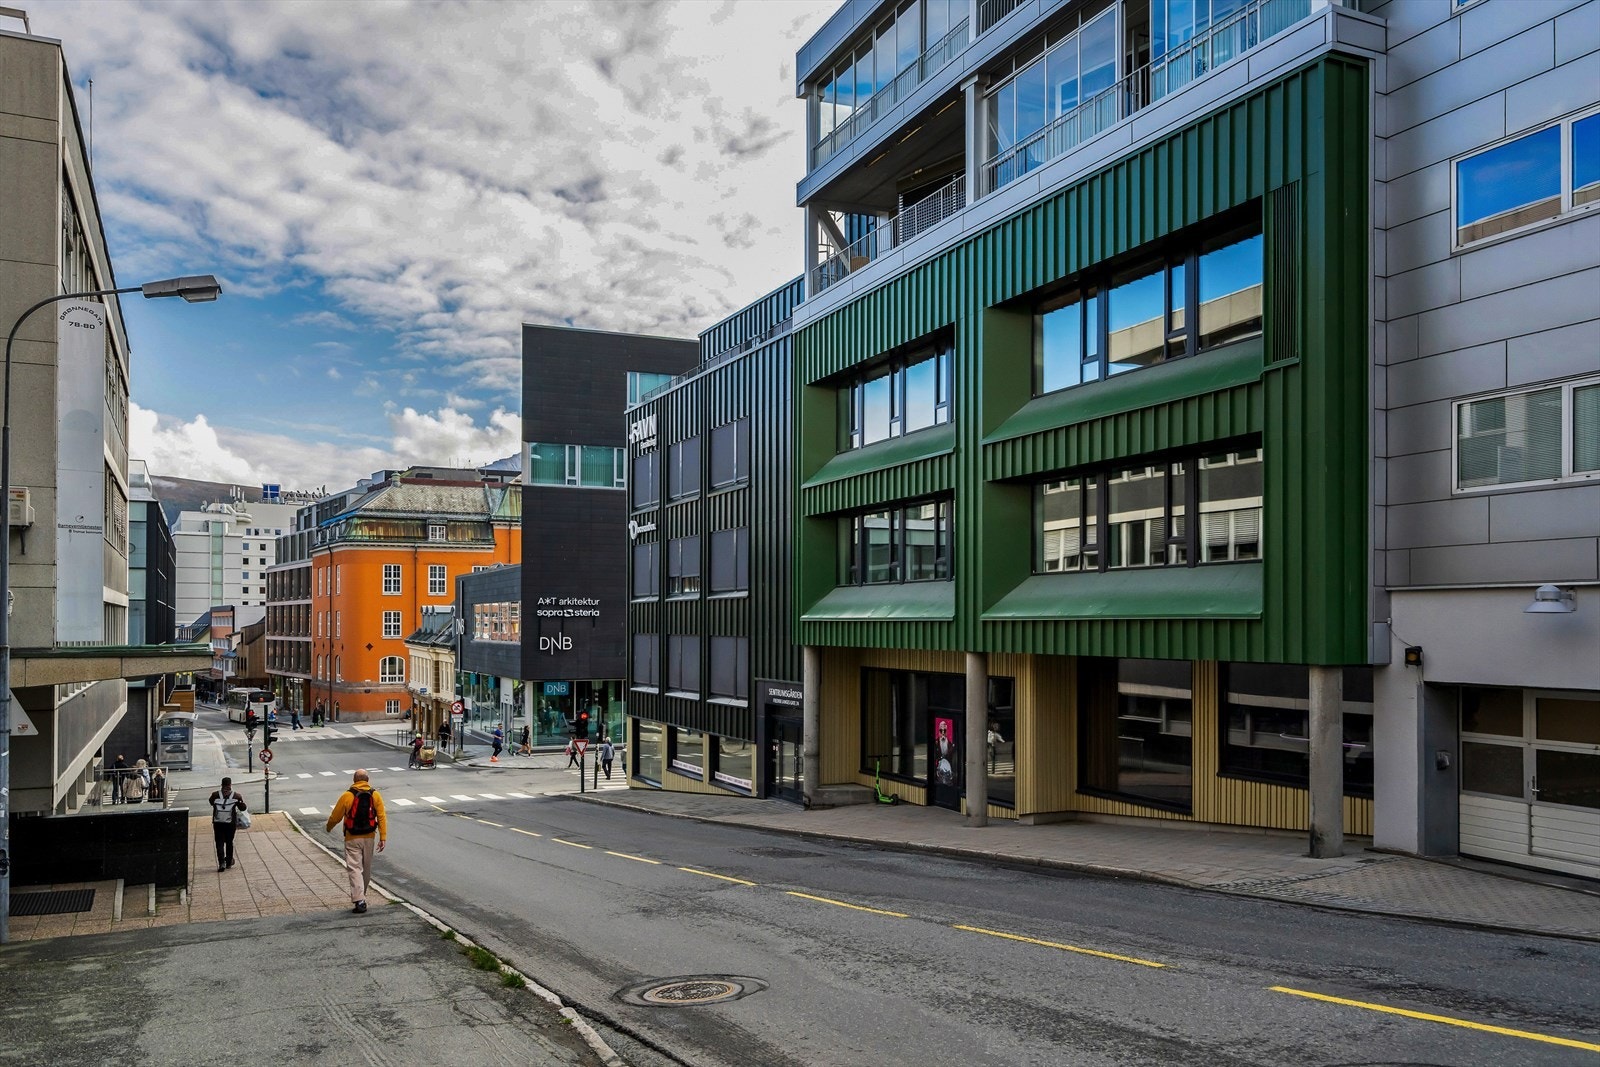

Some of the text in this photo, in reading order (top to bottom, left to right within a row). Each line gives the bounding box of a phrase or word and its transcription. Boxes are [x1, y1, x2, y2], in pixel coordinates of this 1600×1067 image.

[69, 321, 95, 329] 78-80
[559, 597, 600, 606] arkitektur
[537, 608, 600, 618] sopra steria
[540, 632, 573, 655] DNB
[547, 682, 567, 695] DNB
